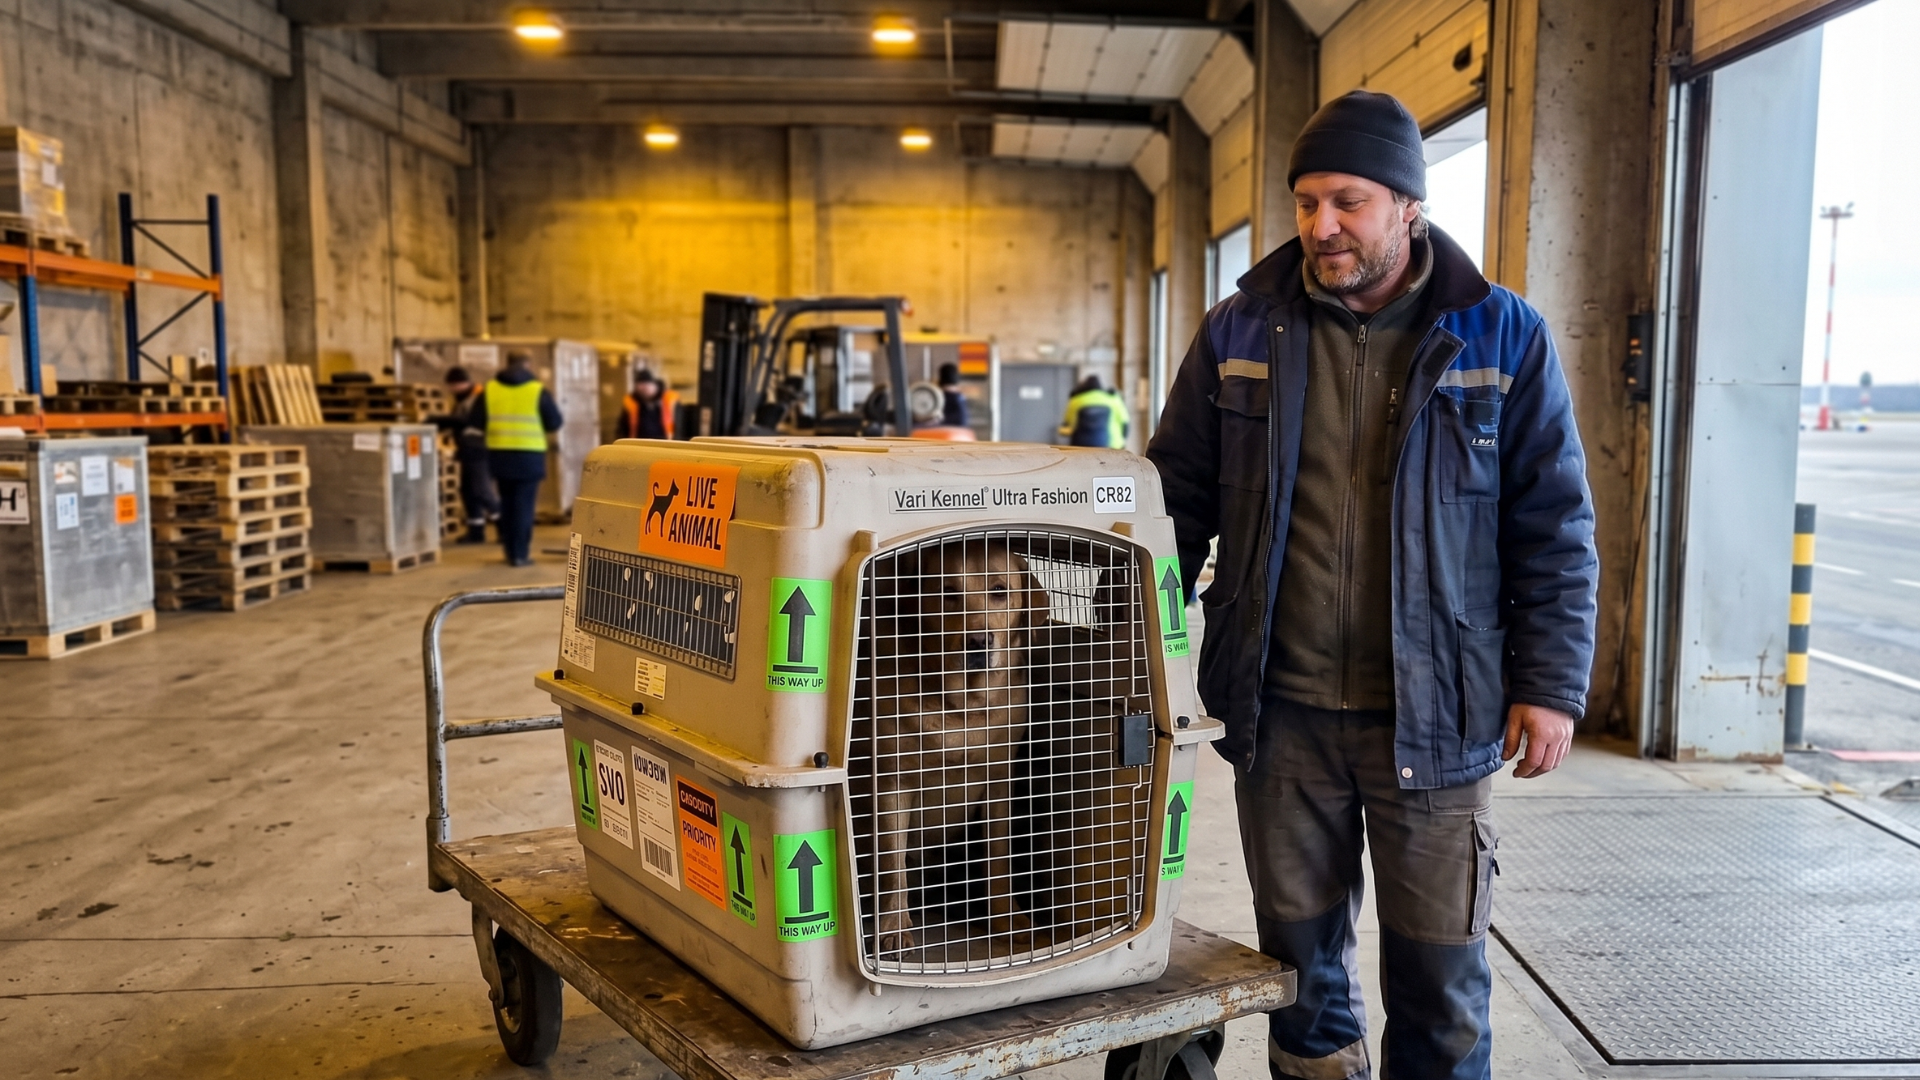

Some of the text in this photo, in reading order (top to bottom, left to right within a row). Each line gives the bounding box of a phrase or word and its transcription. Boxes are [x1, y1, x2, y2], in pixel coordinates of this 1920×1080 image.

[686, 475, 718, 510] LIVE
[894, 490, 926, 508] Vari
[992, 488, 1027, 506] Ultra
[1031, 487, 1088, 505] Fashion
[1096, 486, 1132, 503] CR82
[668, 512, 722, 551] ANIMAL
[768, 675, 824, 688] THIS WAY UP
[598, 762, 625, 806] SVO
[682, 820, 716, 853] PRIORITY
[779, 921, 836, 937] THIS WAY UP
